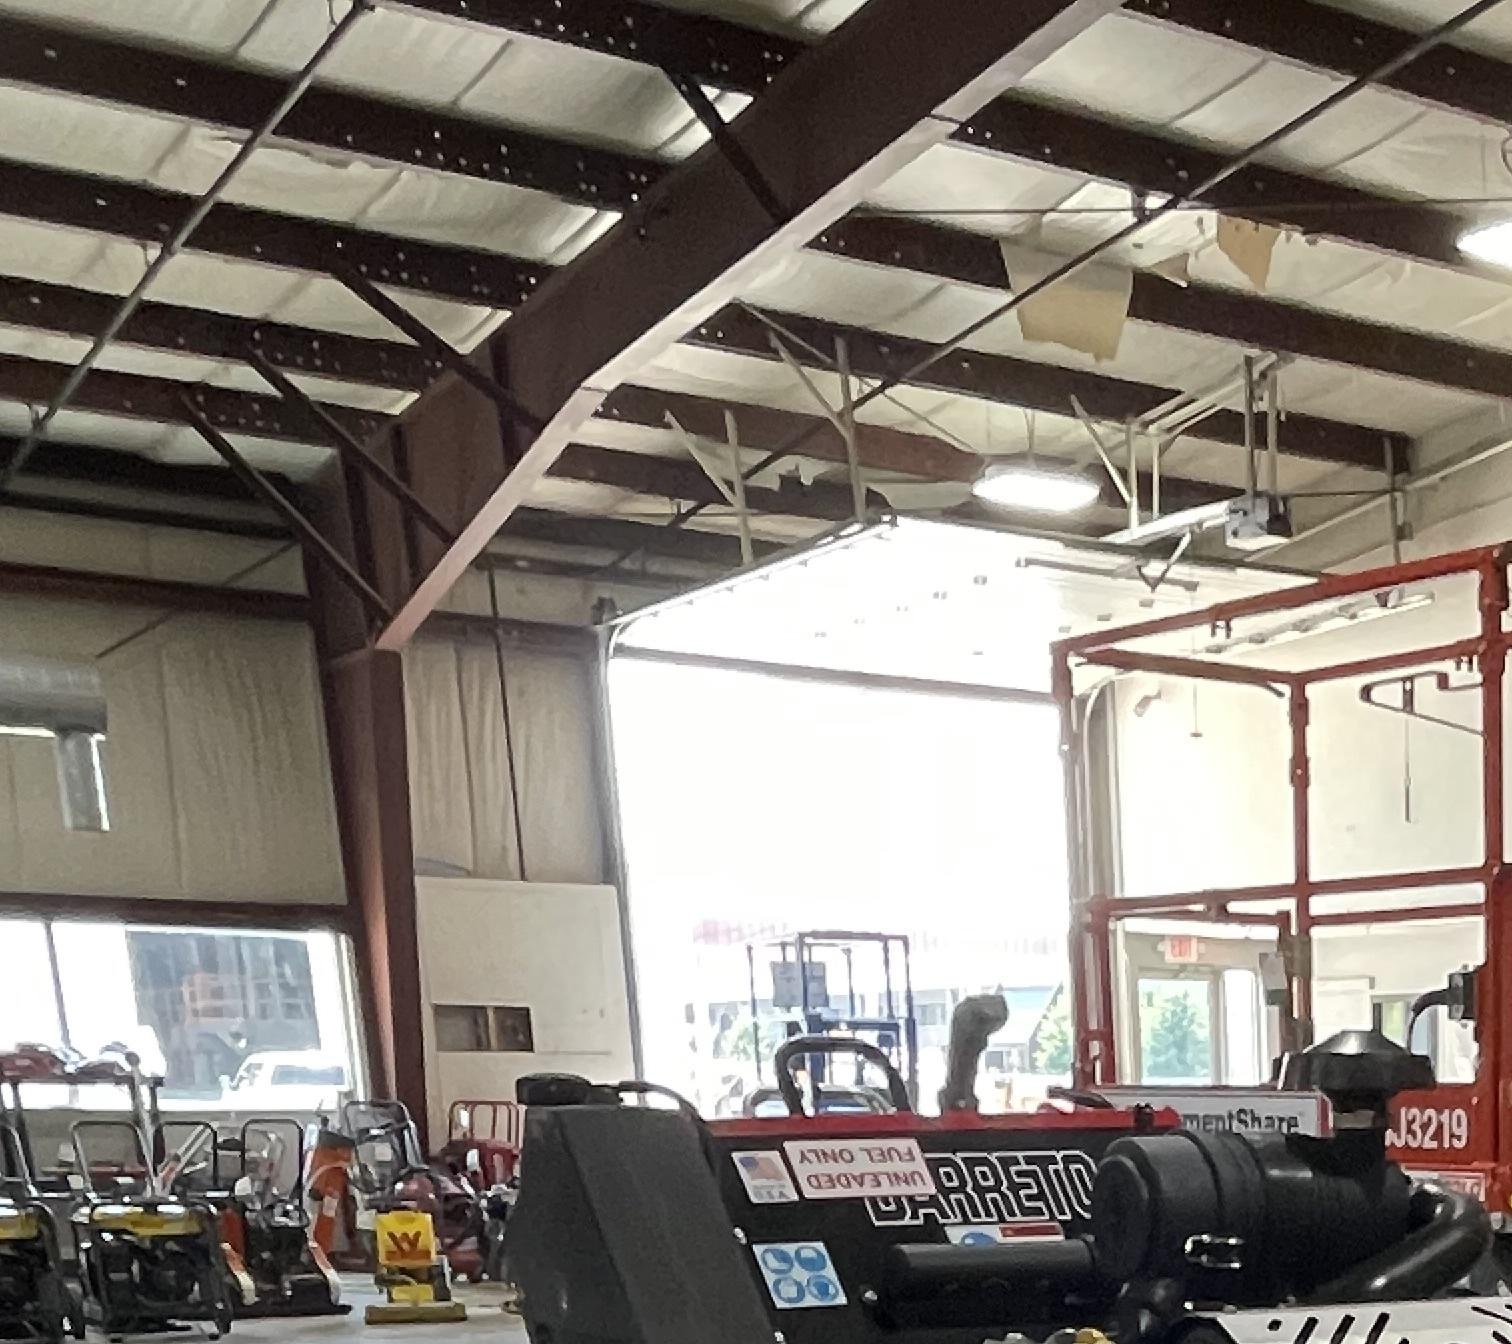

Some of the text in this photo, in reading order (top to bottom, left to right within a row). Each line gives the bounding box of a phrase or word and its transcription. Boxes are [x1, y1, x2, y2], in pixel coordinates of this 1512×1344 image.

[799, 1146, 916, 1164] FUEL ONLY
[806, 1171, 926, 1189] UNLEADED
